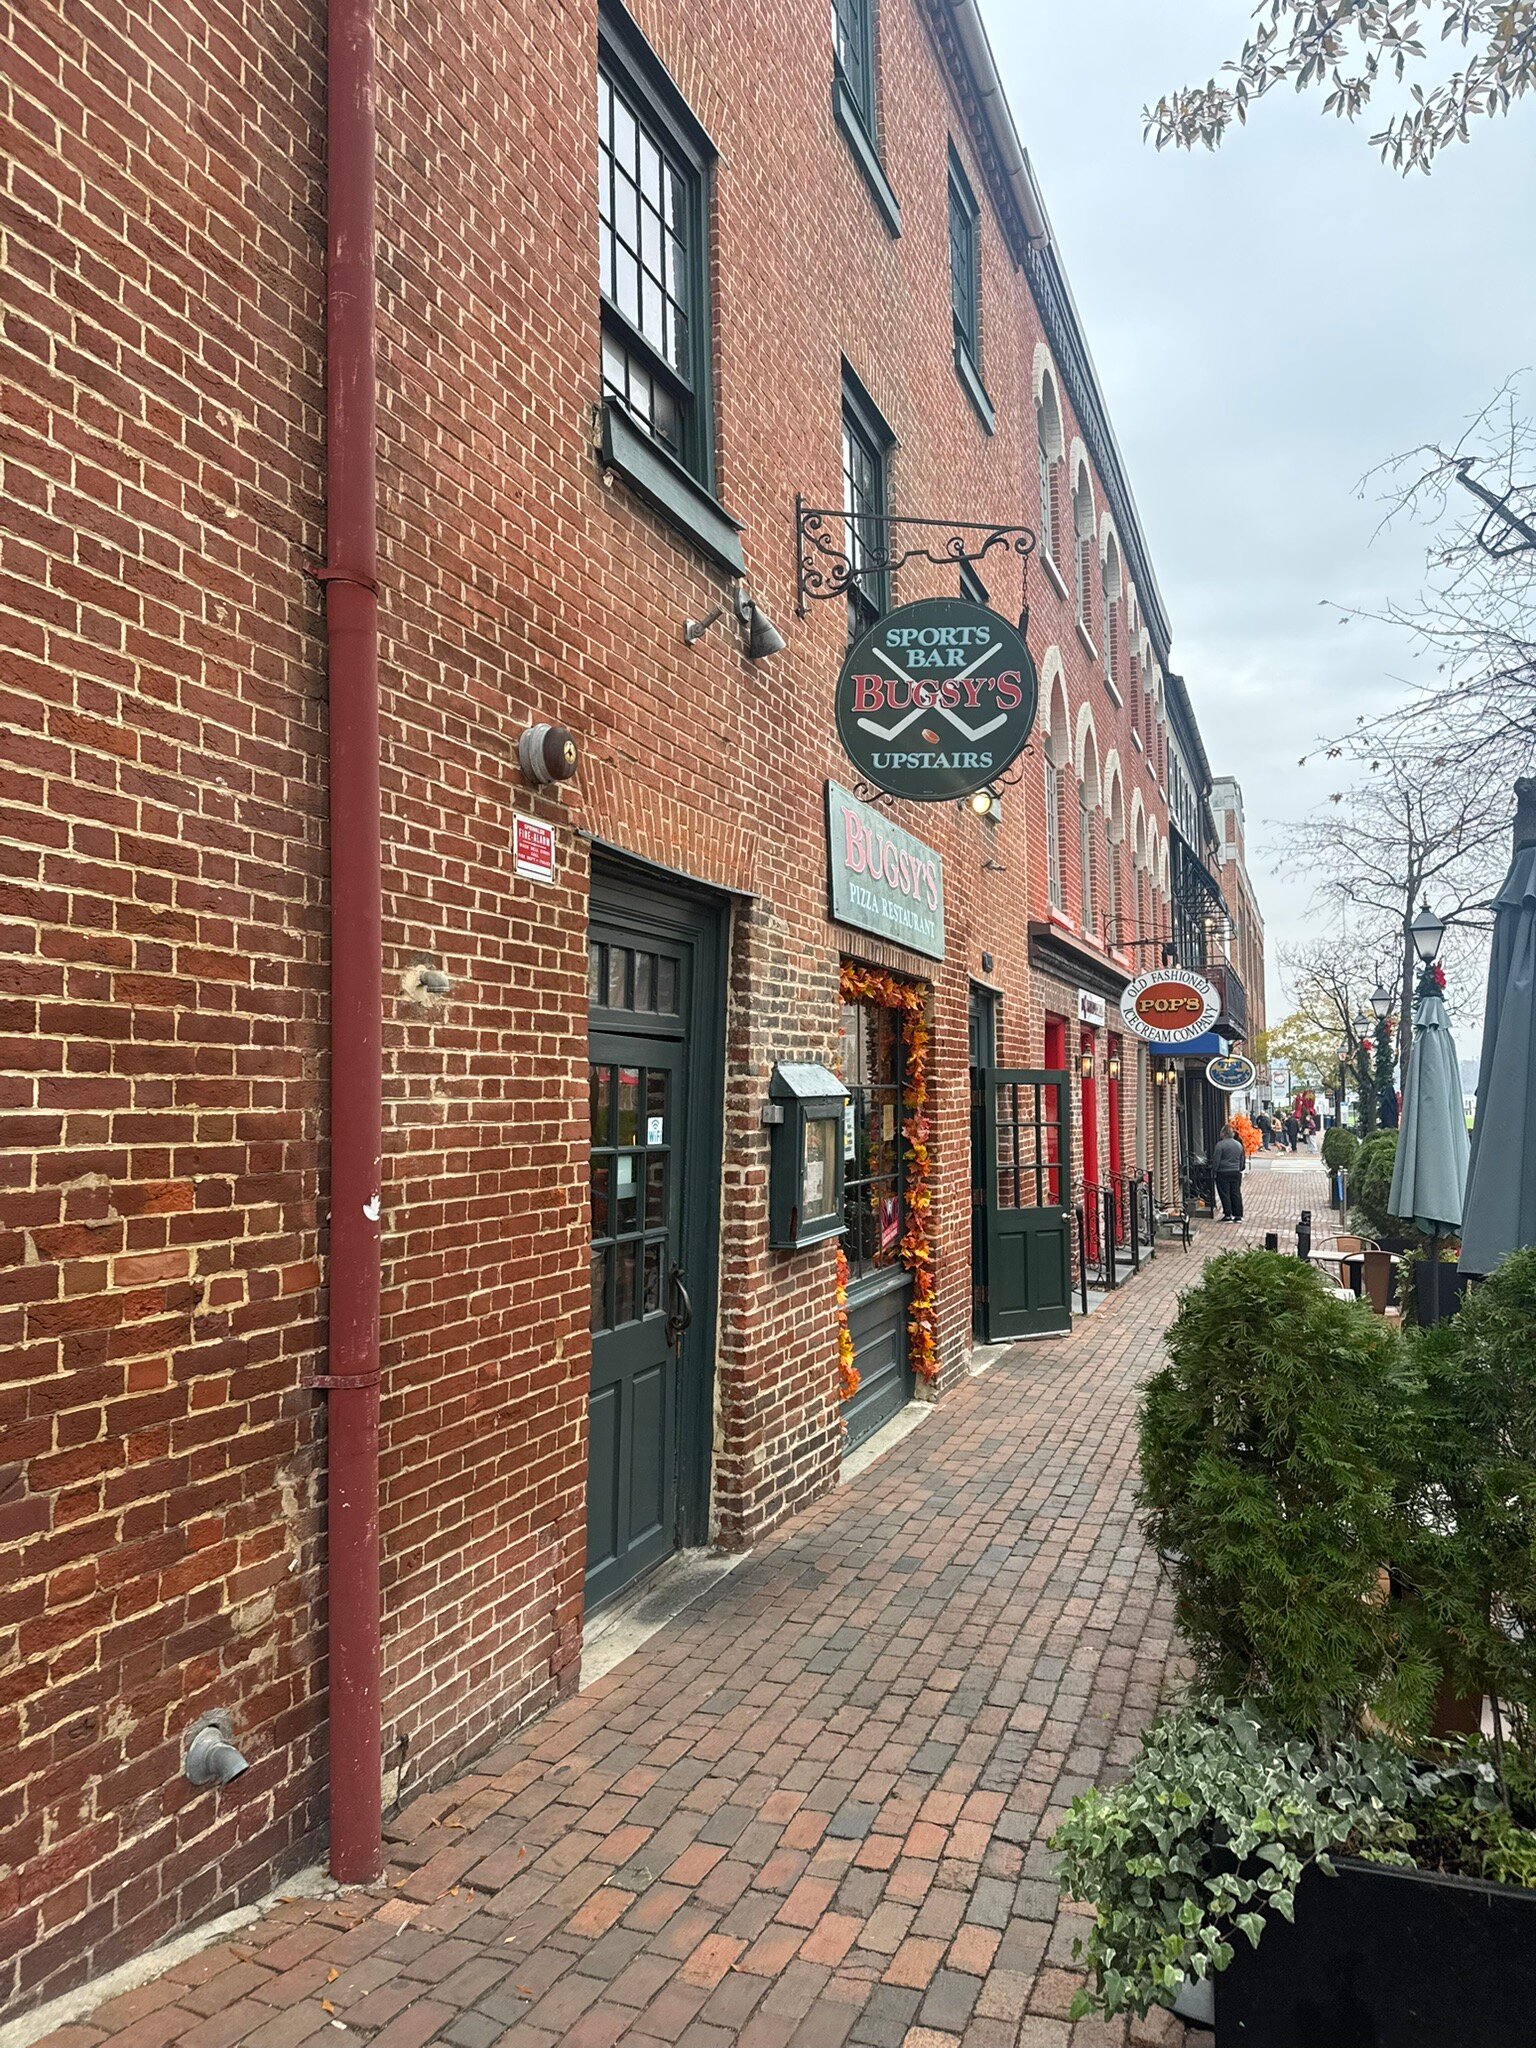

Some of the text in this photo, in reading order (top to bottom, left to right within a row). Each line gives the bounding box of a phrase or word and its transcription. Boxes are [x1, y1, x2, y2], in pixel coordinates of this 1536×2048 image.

[886, 626, 991, 648] SPORTS
[906, 648, 967, 668] BAR
[851, 670, 1023, 712] BUGSY'S
[871, 752, 993, 769] UPSTAIRS
[841, 805, 938, 911] BUGSY'S
[849, 882, 935, 939] PIZZA RESTAURANT
[1127, 970, 1210, 998] OLD FASHIONED
[1139, 998, 1200, 1012] POP'S
[1123, 1004, 1218, 1042] ICE CREAM COMPANY
